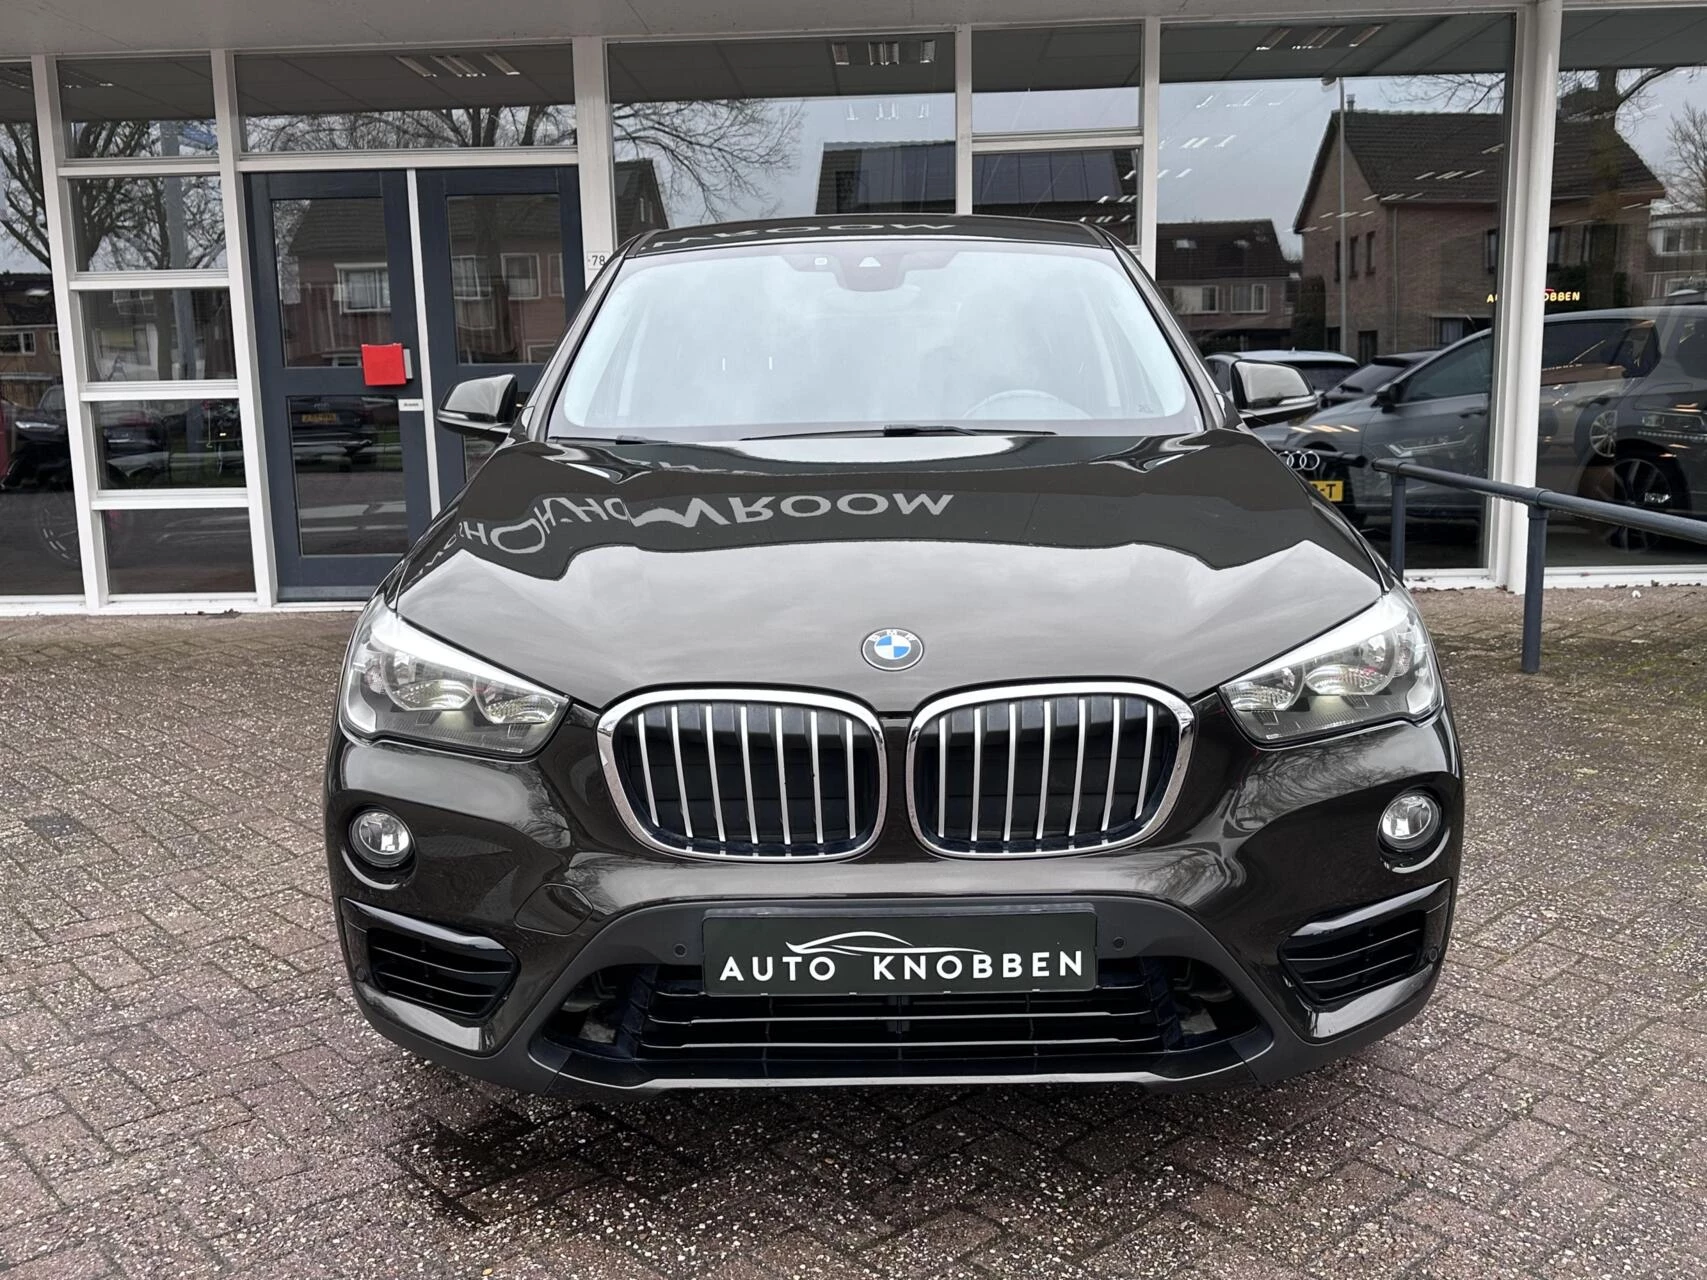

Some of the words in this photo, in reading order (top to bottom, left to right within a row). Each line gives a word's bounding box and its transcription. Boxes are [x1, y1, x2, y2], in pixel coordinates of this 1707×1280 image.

[591, 254, 606, 266] 78
[719, 955, 836, 982] AUTO
[873, 950, 1083, 981] KNOBBEN
